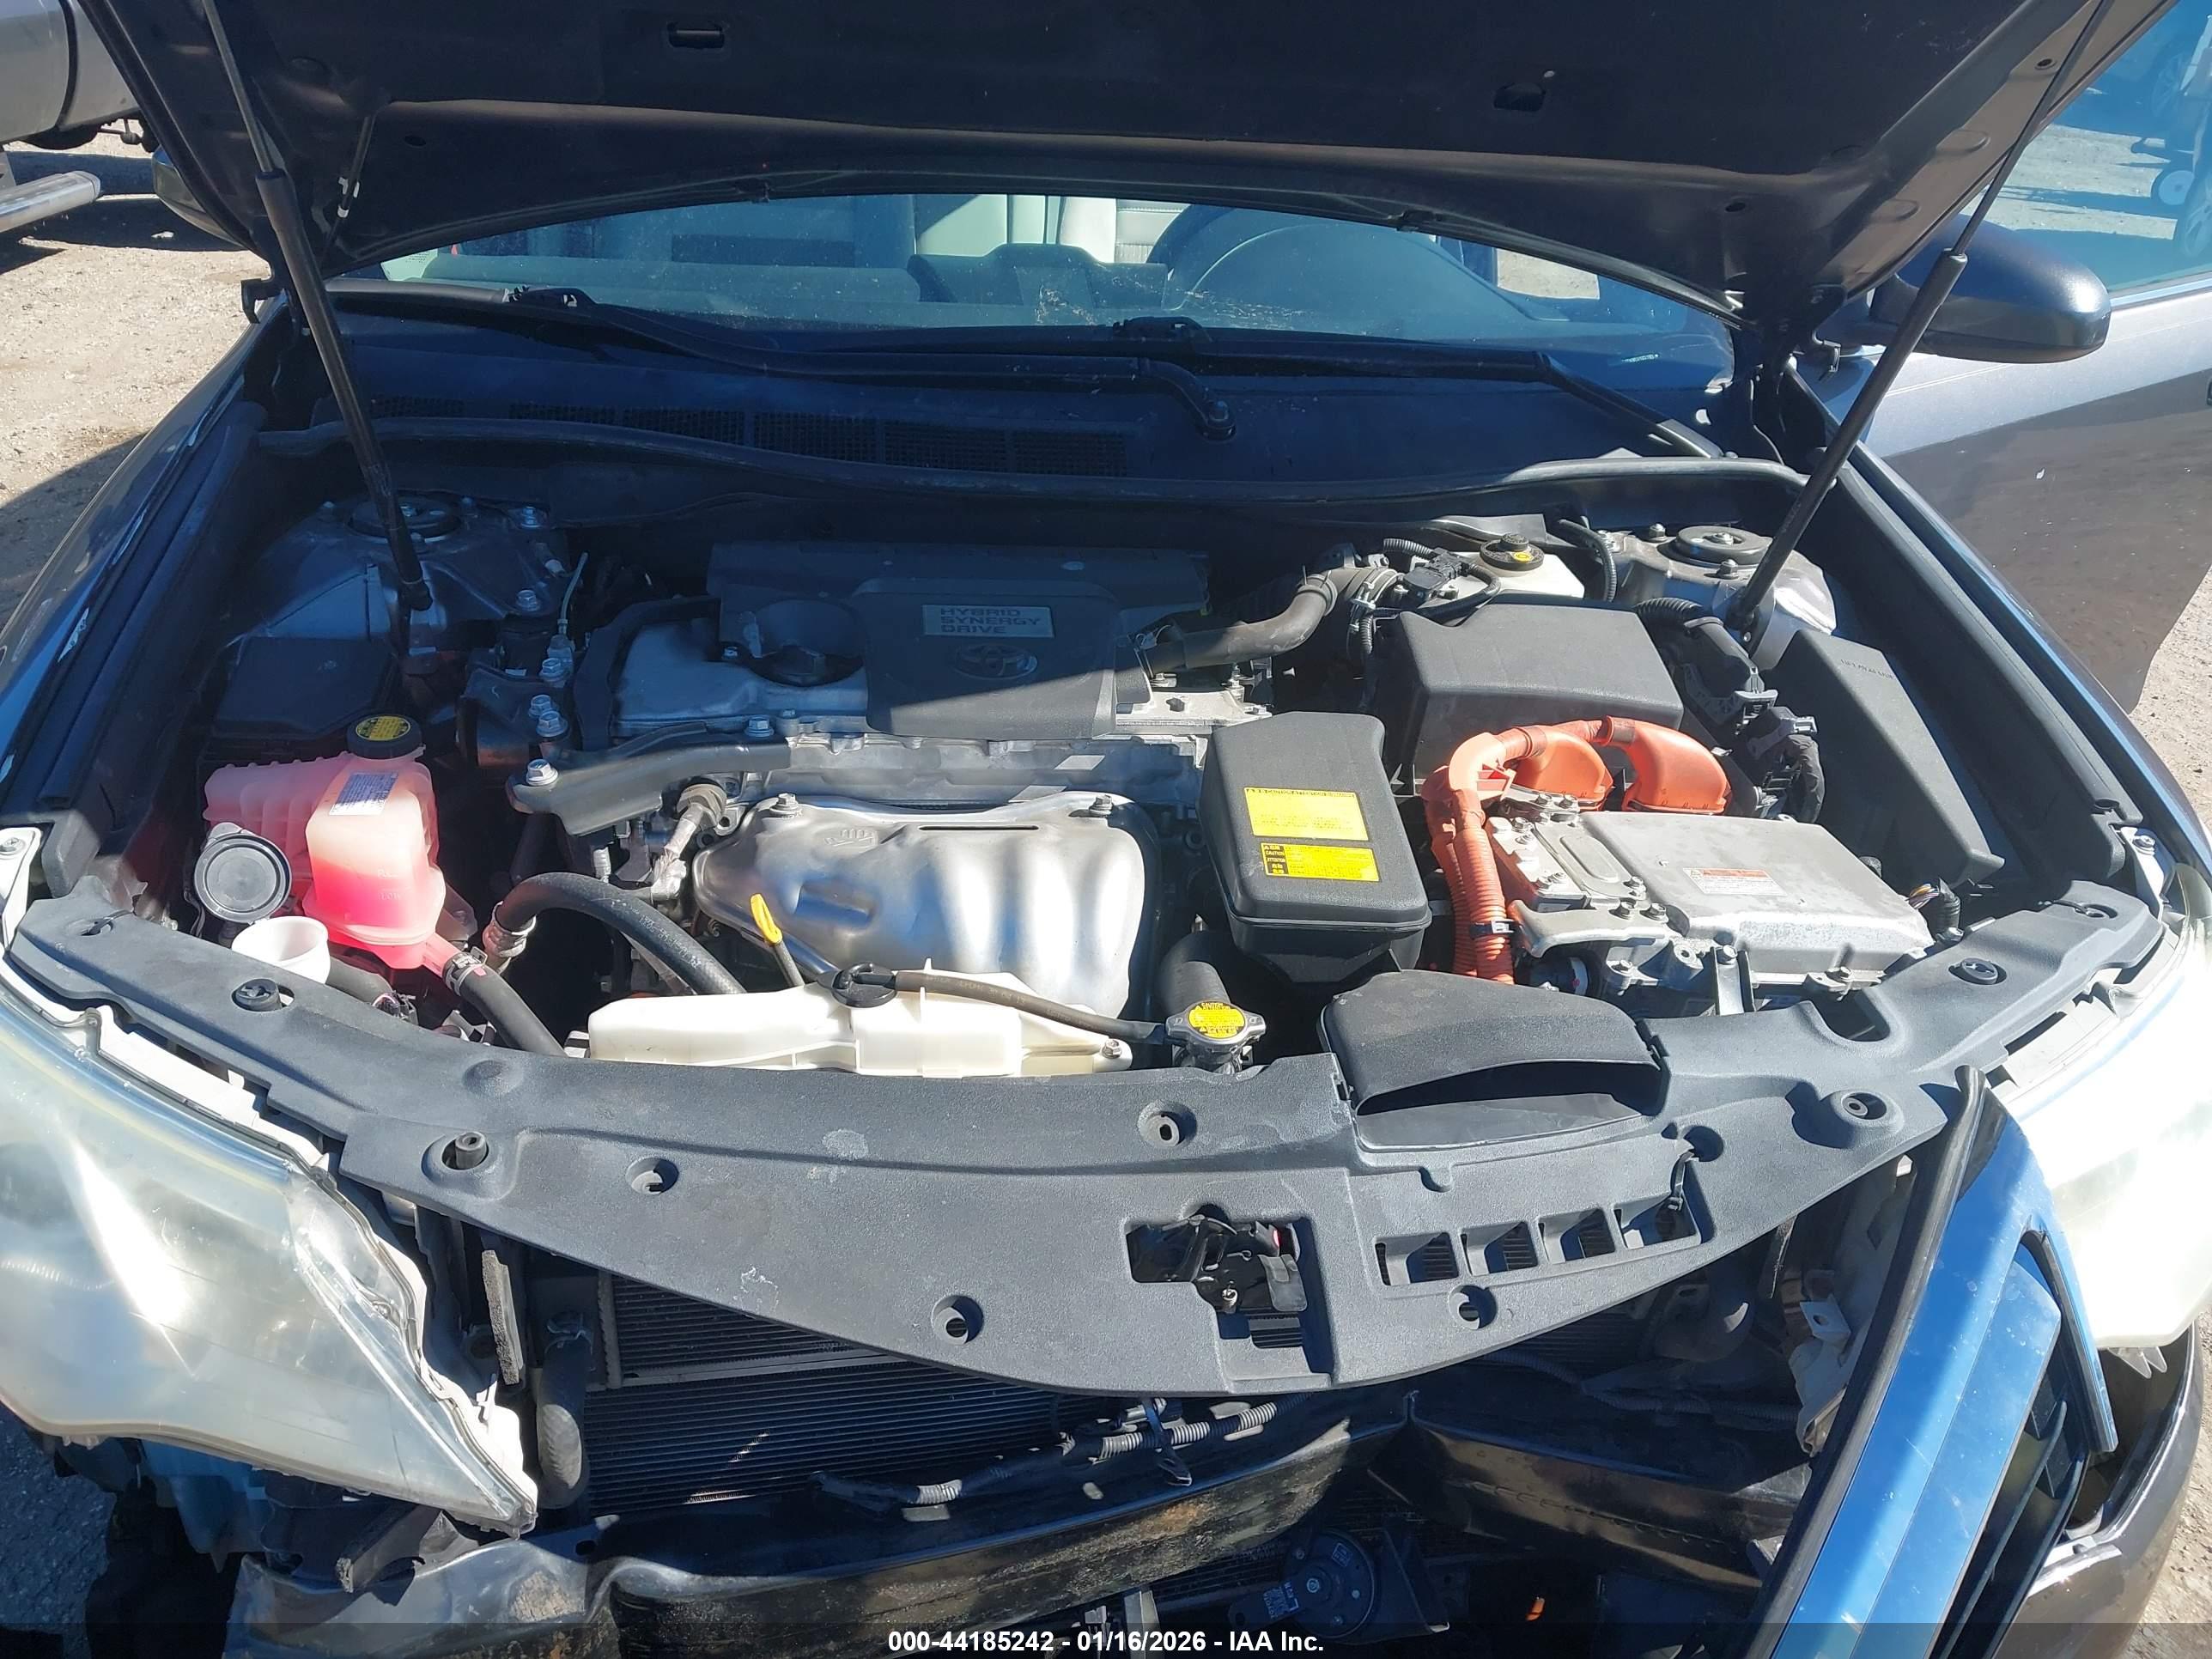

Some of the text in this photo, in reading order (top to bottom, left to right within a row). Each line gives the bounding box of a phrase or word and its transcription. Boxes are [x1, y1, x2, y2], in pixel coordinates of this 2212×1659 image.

[940, 608, 1021, 617] HYBRID
[940, 616, 1041, 626] SYNERGY
[941, 624, 1007, 634] DRIVE
